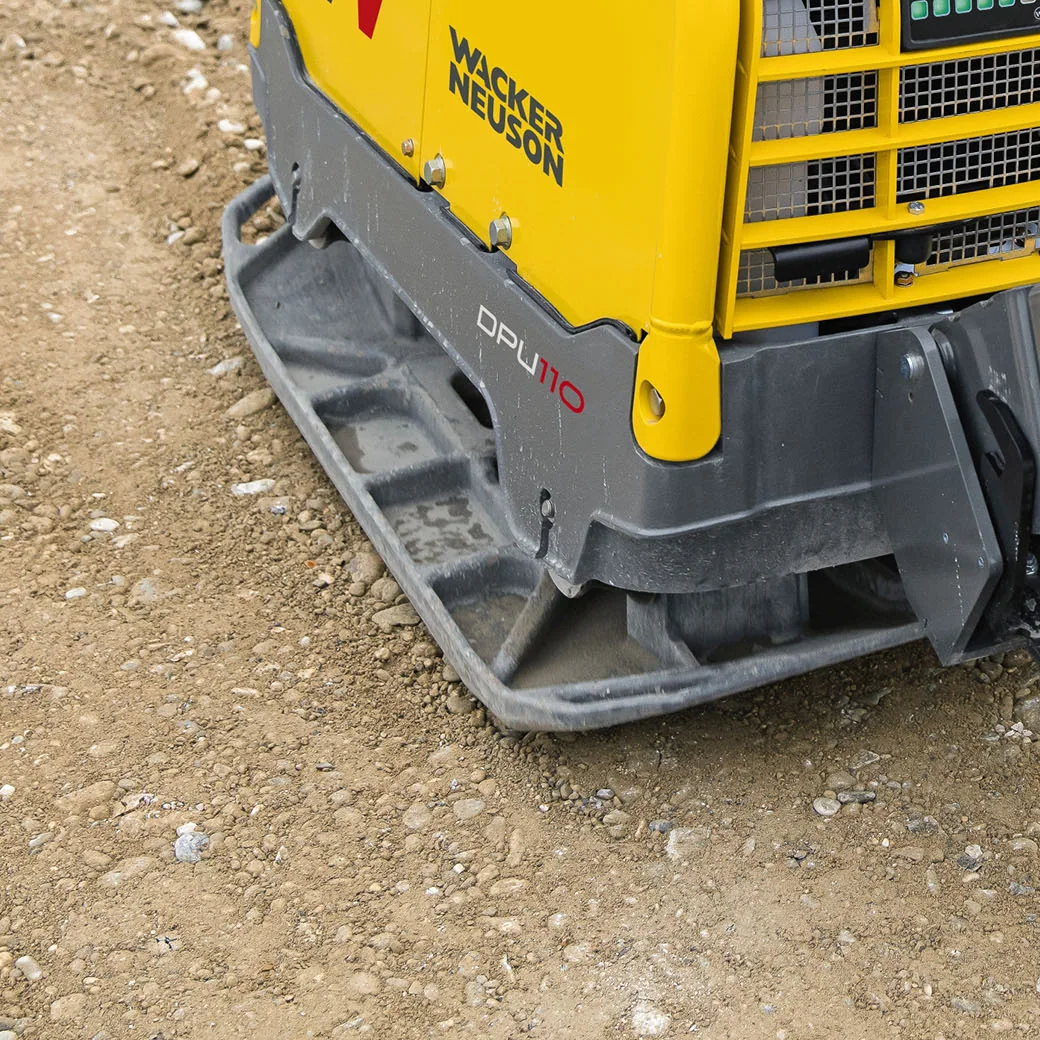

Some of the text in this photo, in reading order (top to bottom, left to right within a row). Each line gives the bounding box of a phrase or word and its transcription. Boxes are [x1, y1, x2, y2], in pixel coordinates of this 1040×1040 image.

[448, 26, 563, 154] WACKER
[448, 61, 563, 187] NEUSON
[476, 304, 585, 414] DPU110
